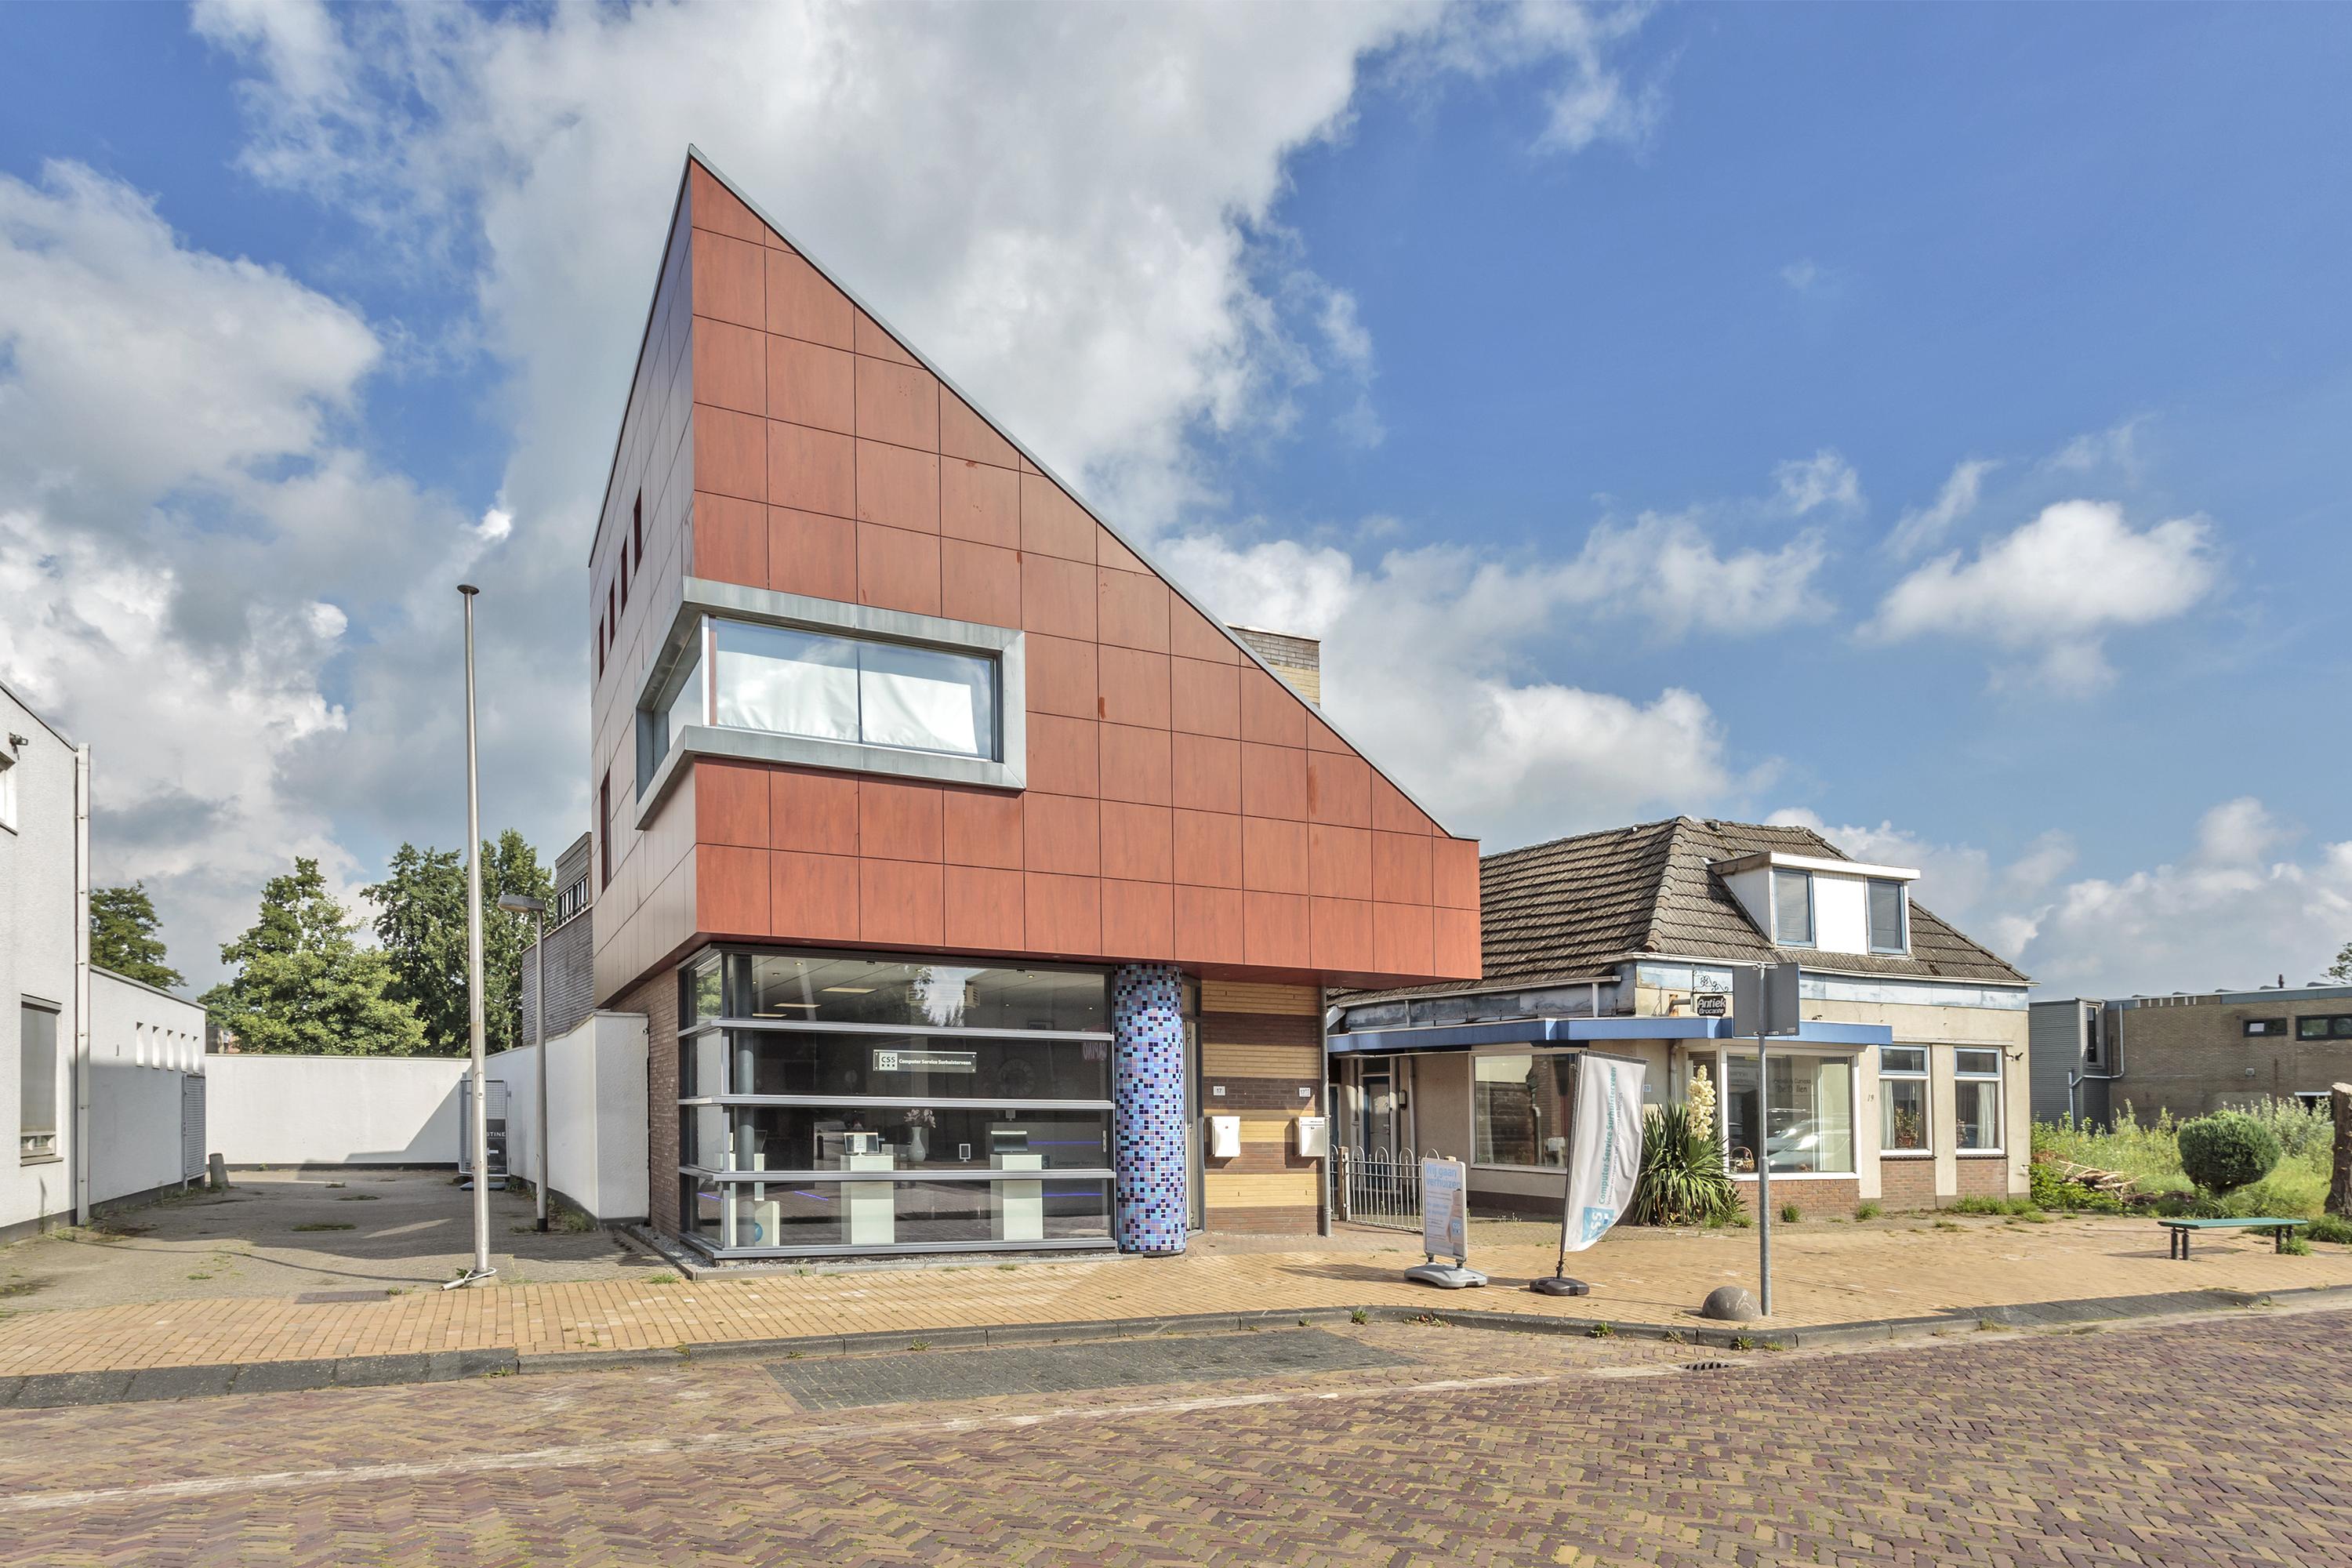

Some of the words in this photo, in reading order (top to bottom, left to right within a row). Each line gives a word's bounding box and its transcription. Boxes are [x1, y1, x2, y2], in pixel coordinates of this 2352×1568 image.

[1697, 998, 1726, 1008] Antiek
[1606, 1067, 1617, 1130] Surhuisterveen
[1867, 1094, 1875, 1102] 19
[1602, 1131, 1613, 1162] Service
[1426, 1163, 1437, 1178] Wij
[1438, 1167, 1457, 1178] gaan
[1426, 1177, 1461, 1189] verhuizen
[1599, 1163, 1610, 1204] Computer
